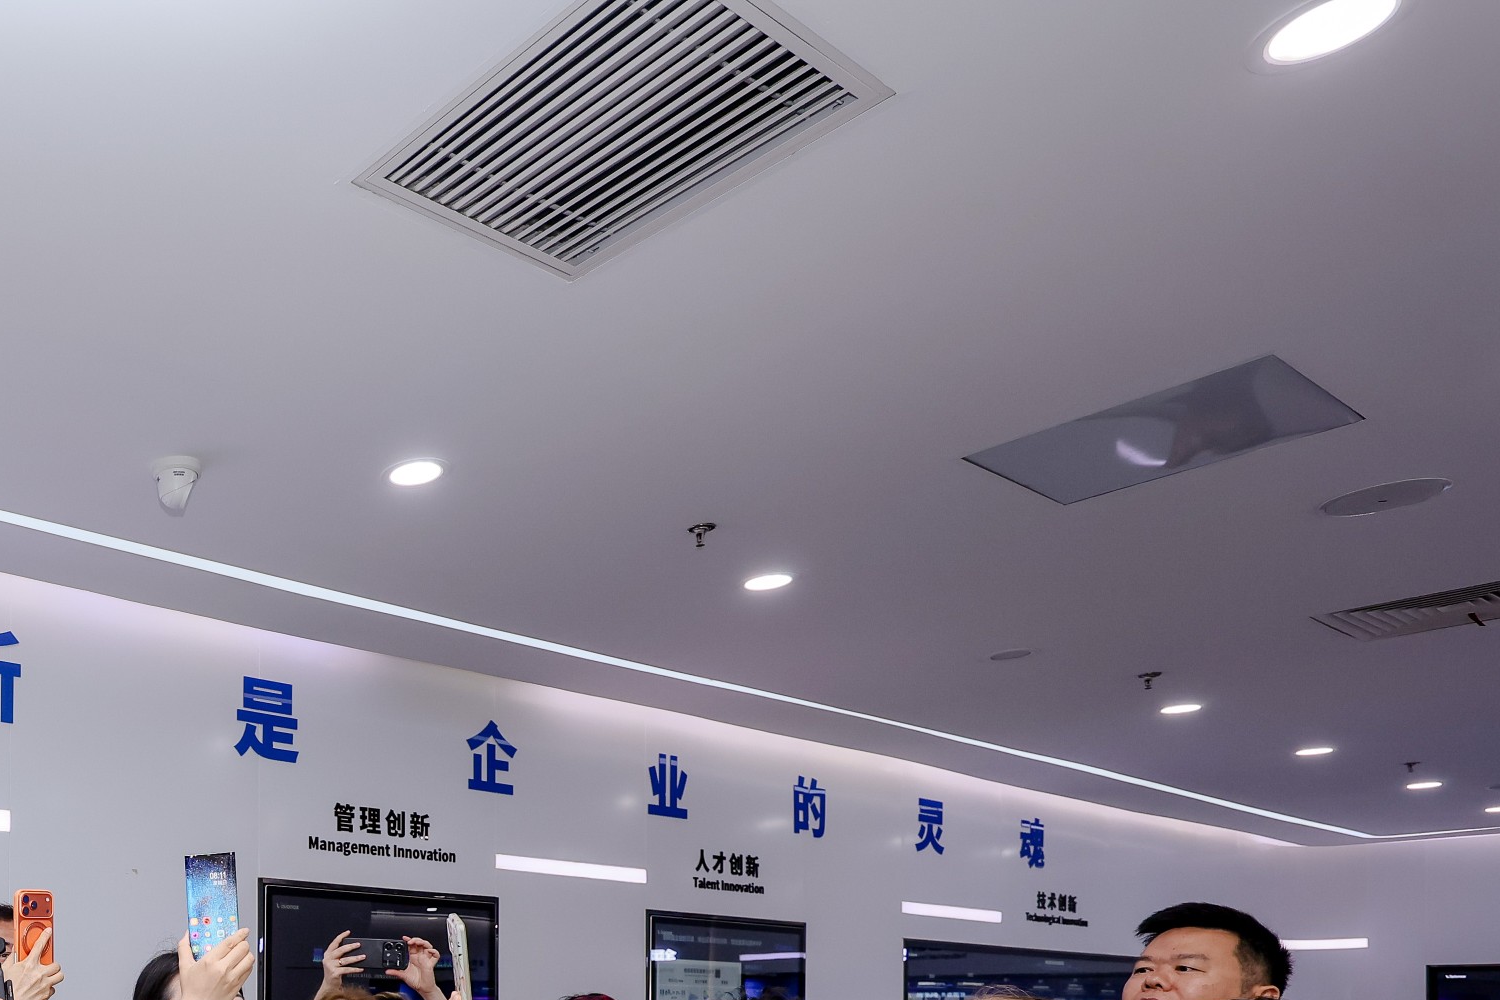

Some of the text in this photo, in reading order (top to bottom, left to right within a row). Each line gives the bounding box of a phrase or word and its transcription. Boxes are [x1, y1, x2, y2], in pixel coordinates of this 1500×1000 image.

[333, 802, 431, 841] 管理创新
[308, 835, 457, 863] Management Innovation
[695, 849, 760, 878] 人才创新
[693, 877, 765, 894] Talent Innovation
[1036, 890, 1077, 913] 技术创新
